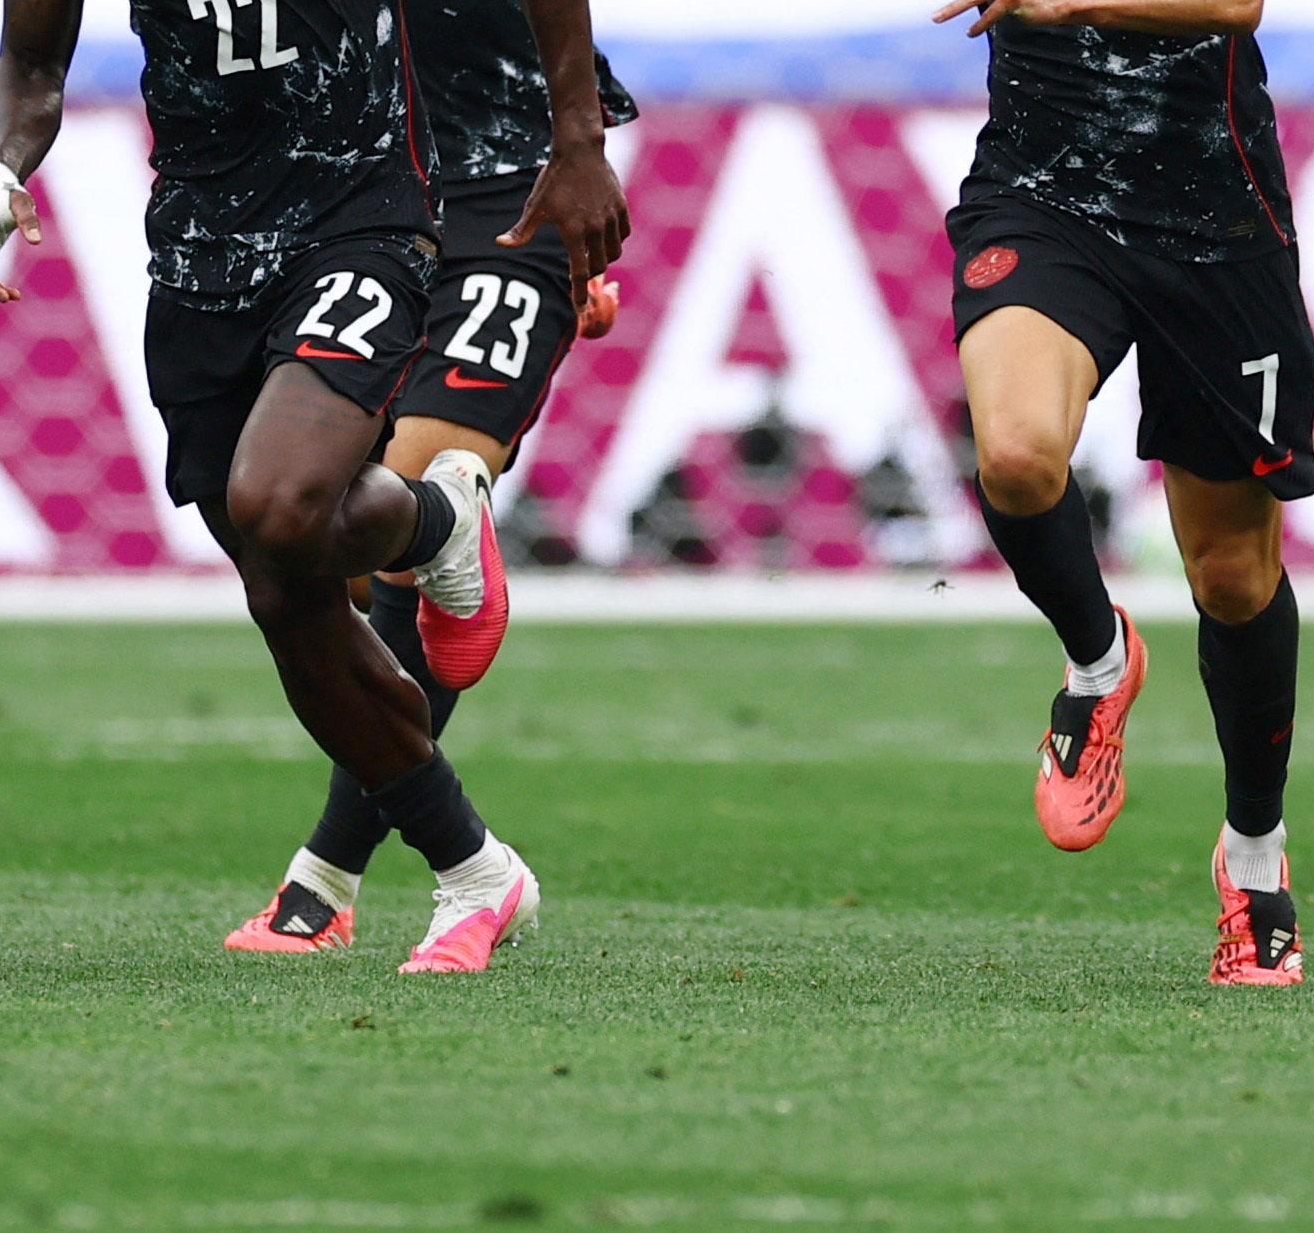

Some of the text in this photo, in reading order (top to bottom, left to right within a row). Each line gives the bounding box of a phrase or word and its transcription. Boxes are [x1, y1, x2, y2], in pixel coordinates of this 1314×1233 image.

[295, 271, 393, 360] 22
[443, 273, 541, 380] 23
[1241, 352, 1280, 446] 7
